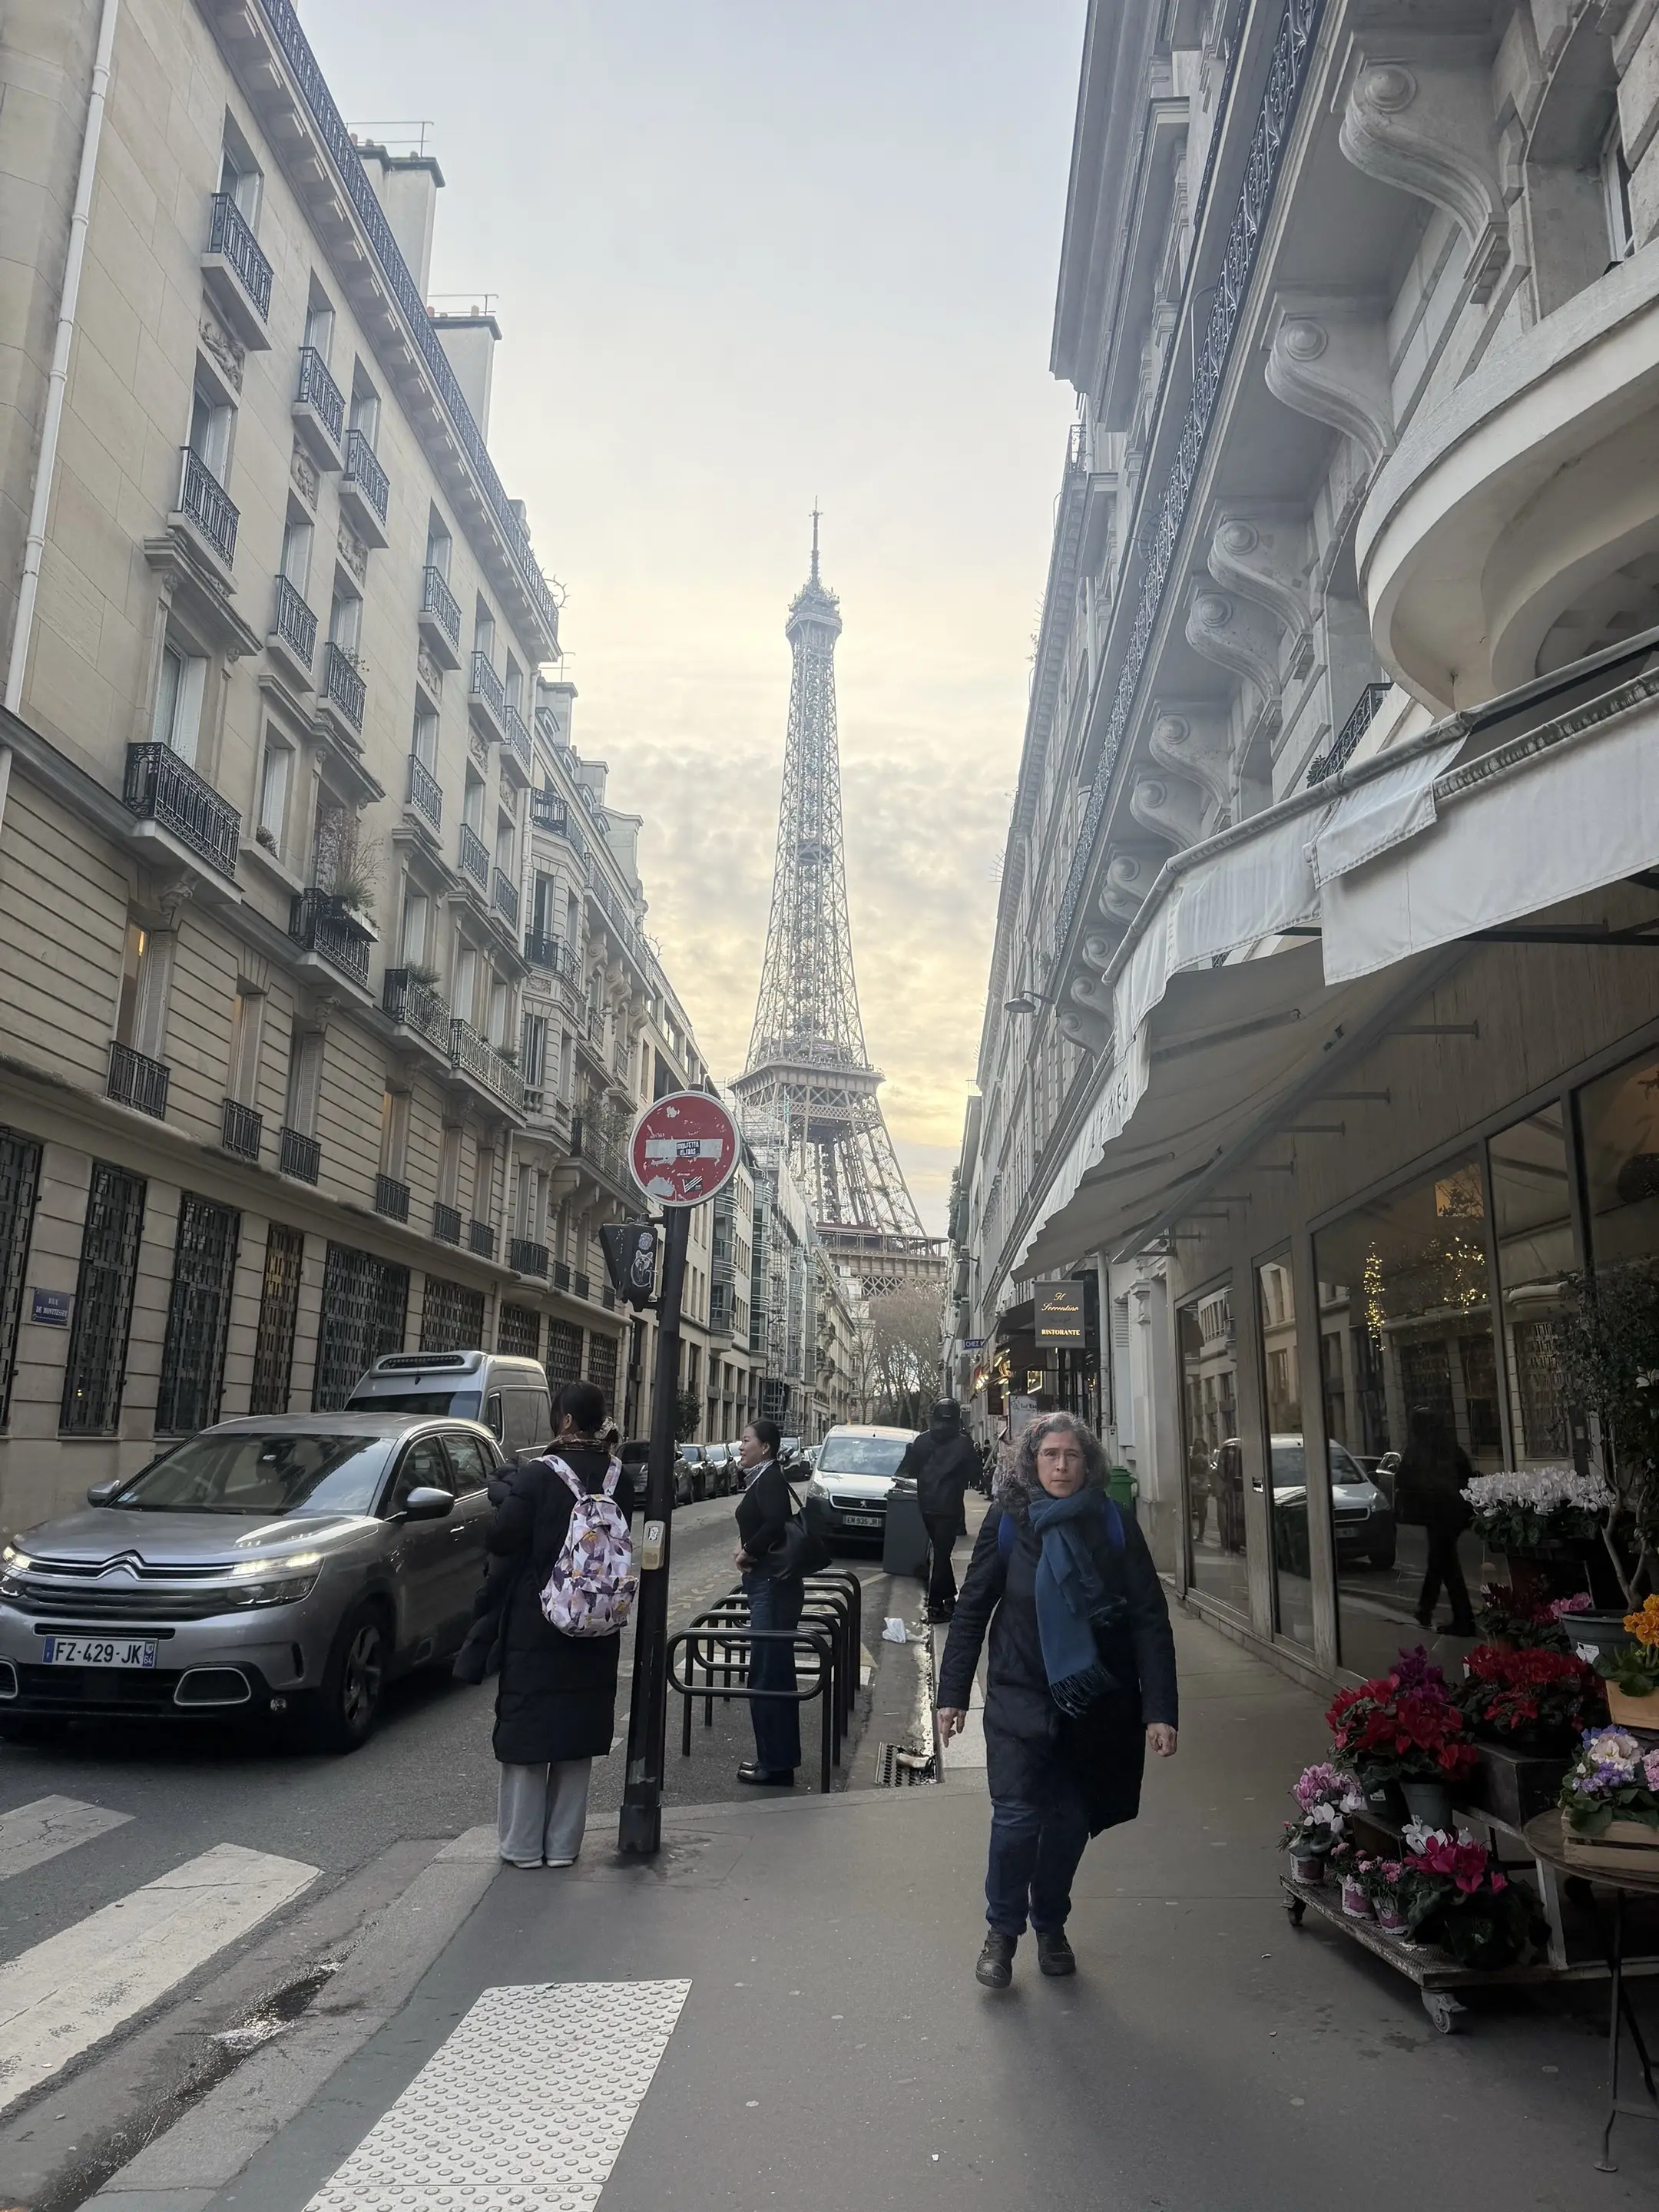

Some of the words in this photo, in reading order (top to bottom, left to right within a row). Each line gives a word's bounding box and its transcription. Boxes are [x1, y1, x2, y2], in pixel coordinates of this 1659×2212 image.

[48, 1297, 59, 1306] RUE
[1041, 1303, 1079, 1312] Sorrentino
[55, 1641, 142, 1664] FZ-429-JK
